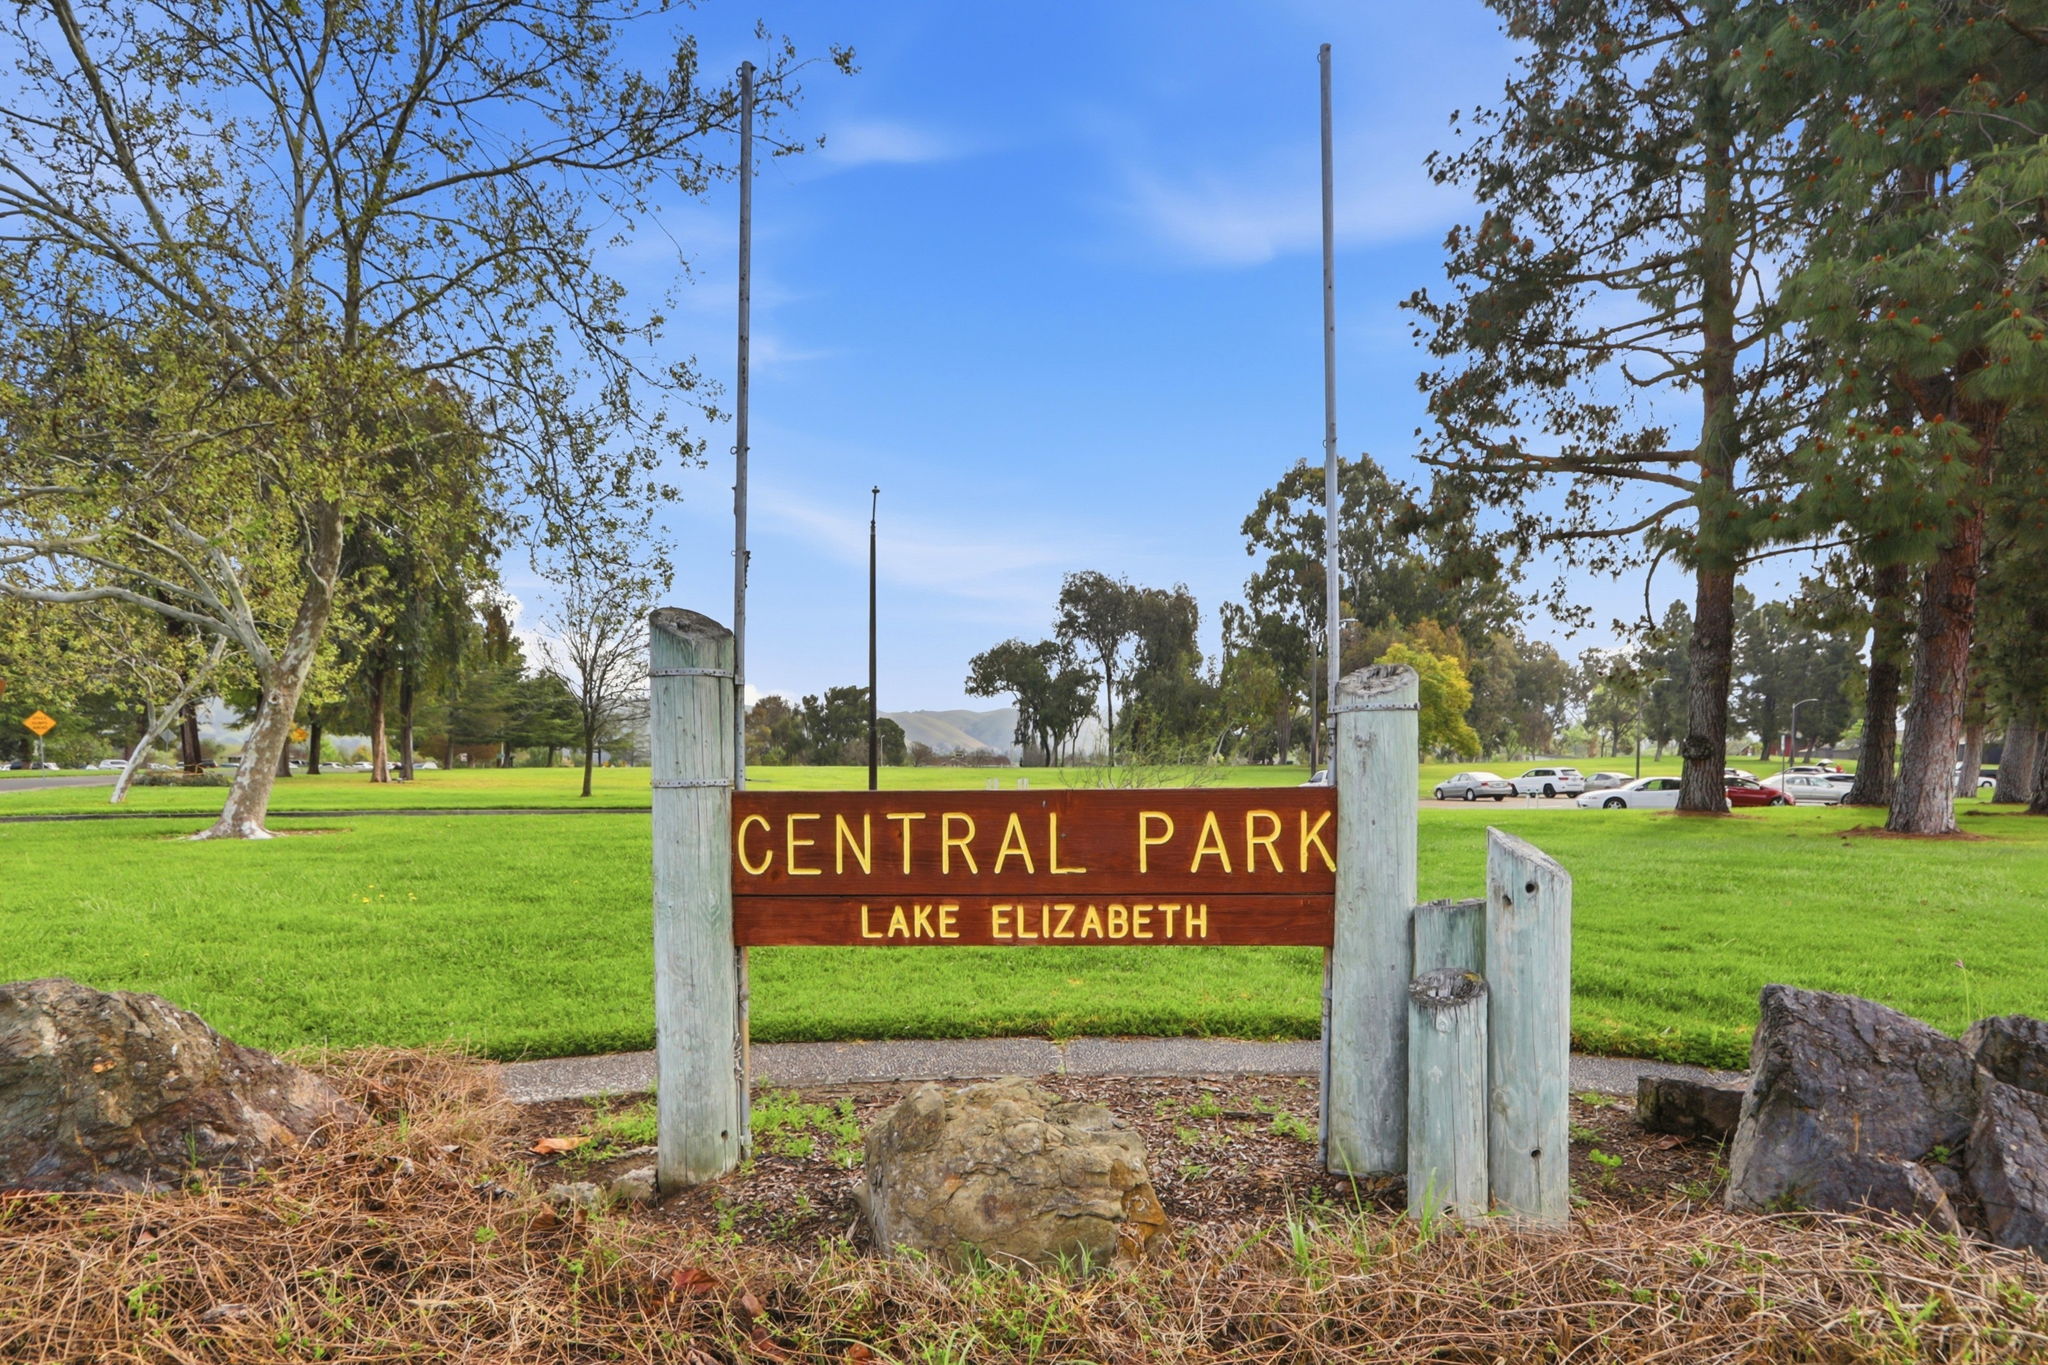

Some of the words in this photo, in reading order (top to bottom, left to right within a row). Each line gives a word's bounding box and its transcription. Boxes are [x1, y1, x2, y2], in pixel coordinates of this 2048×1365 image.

[738, 812, 1086, 875] CENTRAL
[1139, 809, 1337, 873] PARK
[861, 904, 960, 939] LAKE
[991, 904, 1207, 939] ELIZABETH
